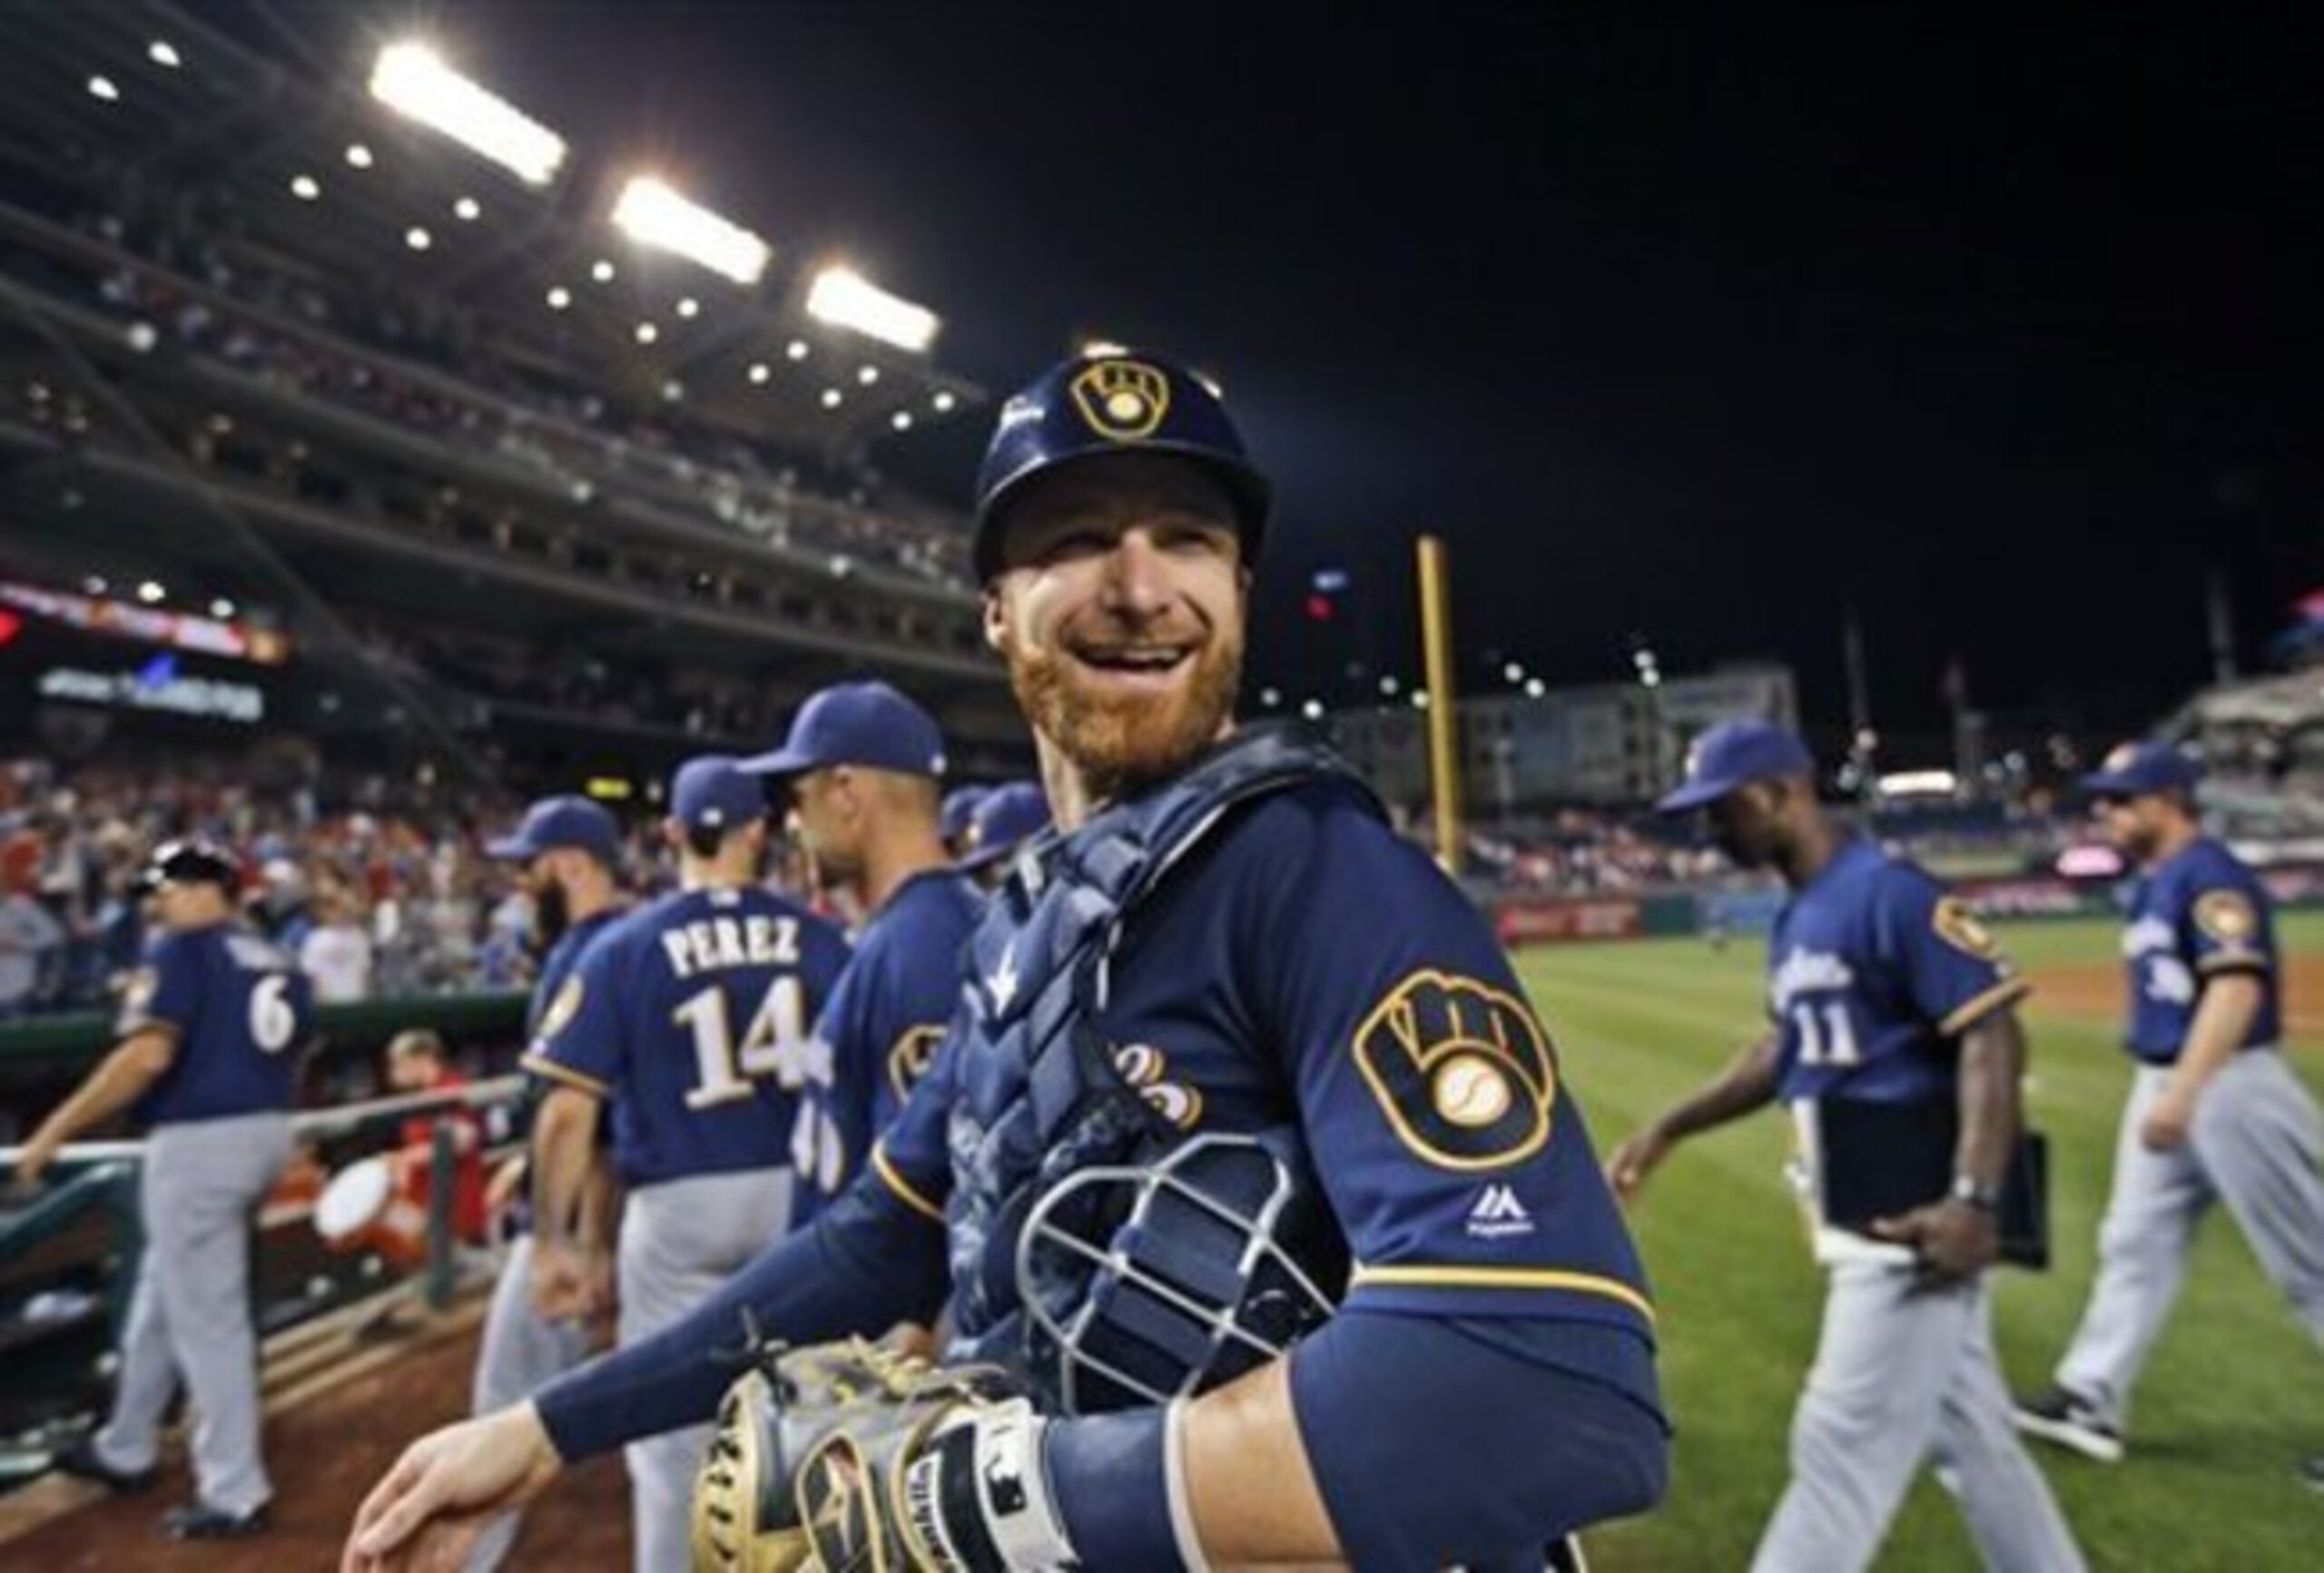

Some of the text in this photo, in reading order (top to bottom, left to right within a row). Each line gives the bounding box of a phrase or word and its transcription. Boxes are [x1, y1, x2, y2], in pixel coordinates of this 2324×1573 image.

[662, 915, 800, 978] PEREZ
[249, 973, 296, 1052] 6
[673, 975, 808, 1110] 14
[1793, 1001, 1861, 1065] 11
